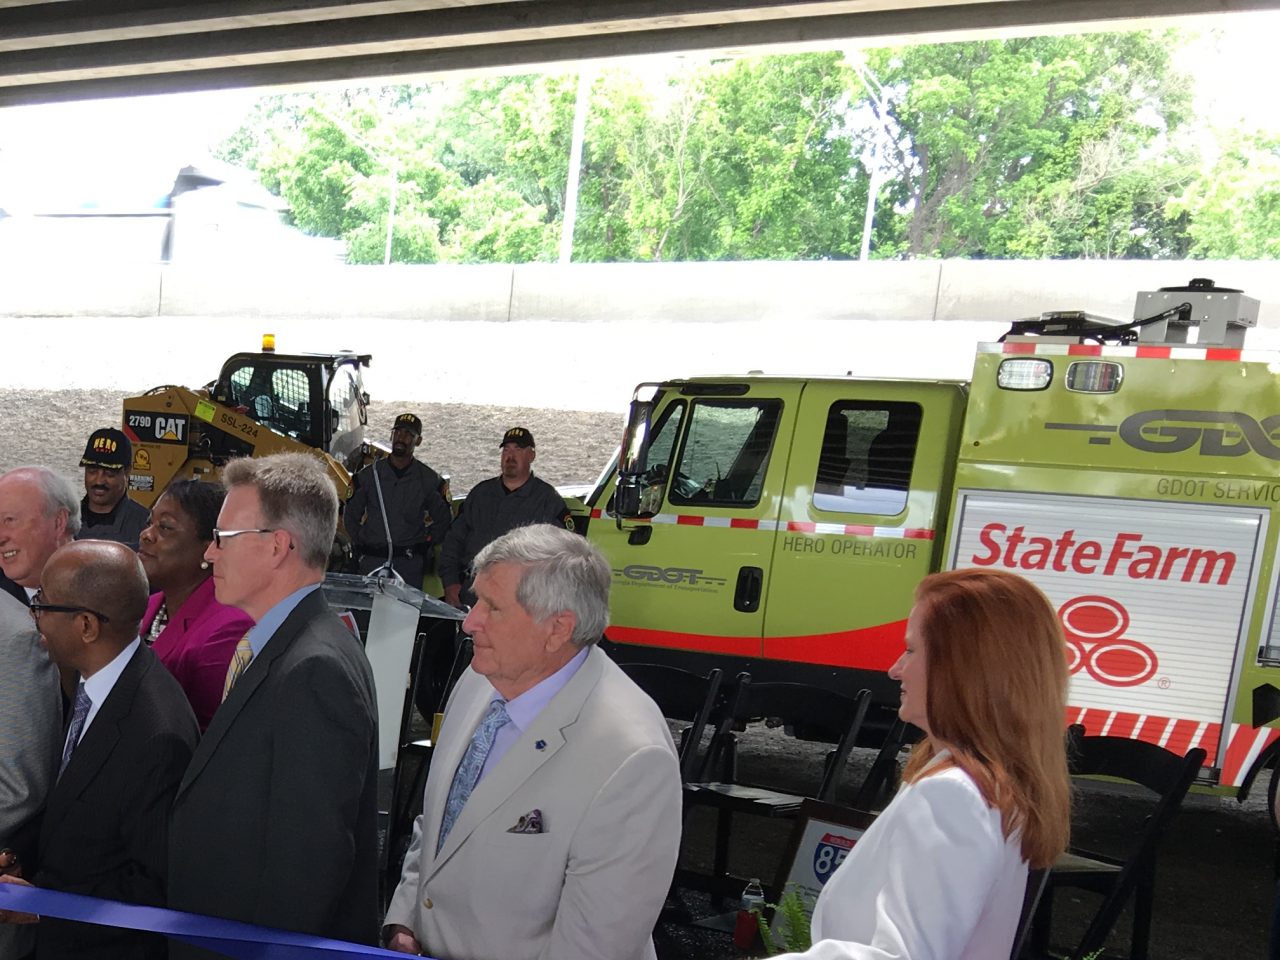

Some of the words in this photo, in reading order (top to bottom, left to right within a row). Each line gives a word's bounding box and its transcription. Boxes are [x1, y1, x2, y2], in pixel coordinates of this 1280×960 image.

[129, 415, 151, 428] 279D
[155, 417, 185, 440] CAT
[220, 413, 259, 439] SSL-224
[93, 438, 117, 452] HERO
[1157, 478, 1209, 497] GDOT
[783, 537, 825, 553] HERO
[831, 539, 917, 559] OPERATOR
[623, 564, 703, 585] GDOT
